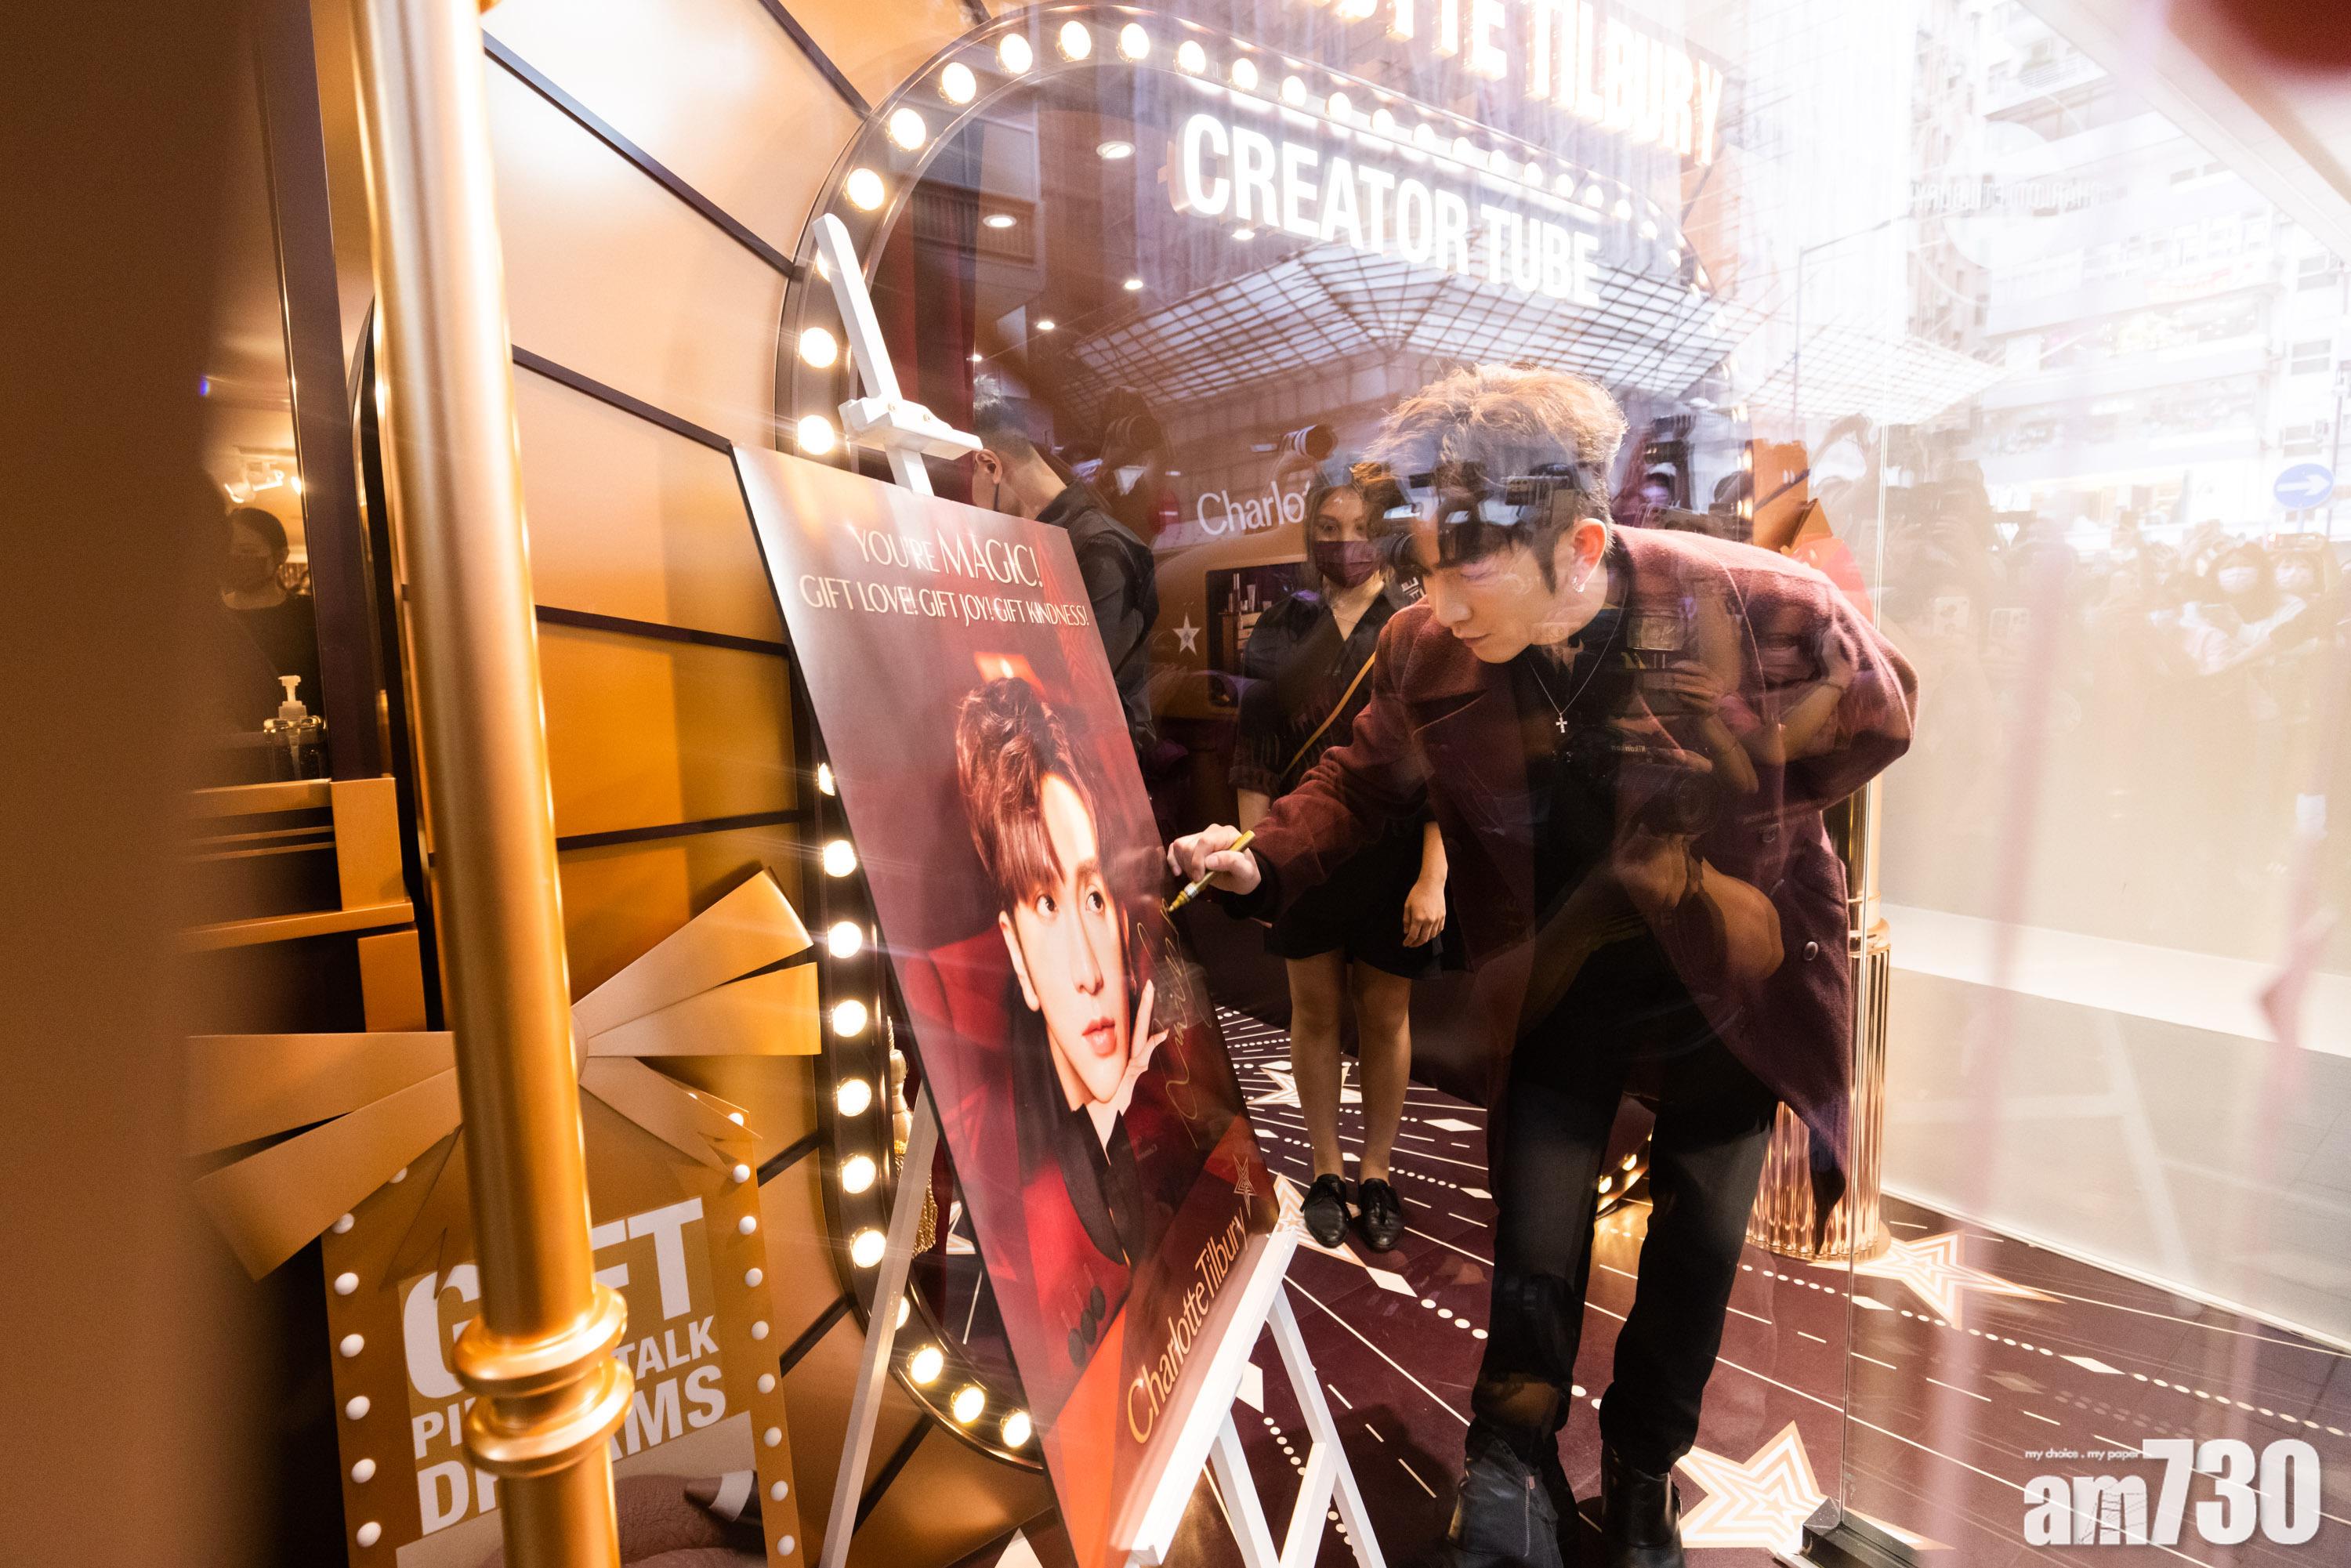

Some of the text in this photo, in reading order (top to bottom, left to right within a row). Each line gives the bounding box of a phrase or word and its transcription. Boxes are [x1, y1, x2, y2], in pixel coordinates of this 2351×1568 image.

[1182, 114, 1600, 307] CREATOR TUBE
[1197, 480, 1311, 536] Charlo
[852, 528, 1044, 588] YOU'RE MAGIC!
[799, 574, 1089, 628] GIFT LOVE! GIFT JOY! GIFT KINDNESS!
[610, 1315, 719, 1381] TALK
